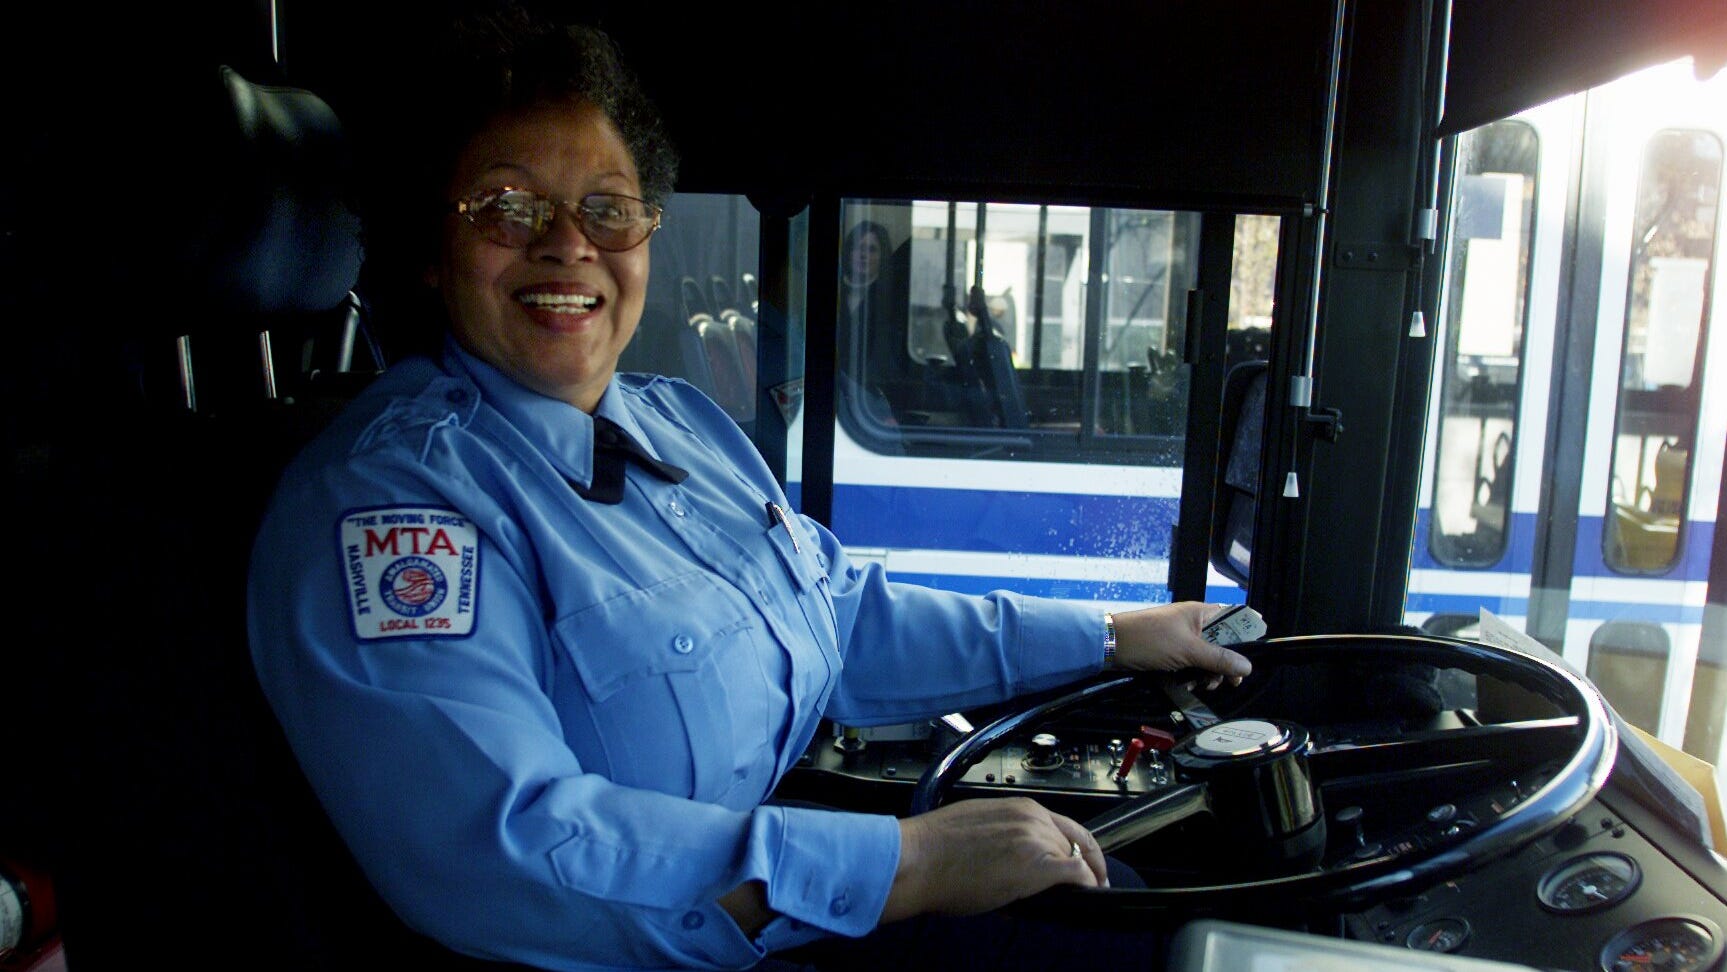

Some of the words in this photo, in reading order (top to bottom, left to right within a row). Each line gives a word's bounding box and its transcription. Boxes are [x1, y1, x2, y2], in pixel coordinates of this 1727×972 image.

[381, 514, 426, 524] MOVING
[364, 527, 459, 557] MTA
[347, 544, 370, 615] NASHVILLE
[457, 546, 474, 614] TENNESSEE
[379, 619, 419, 632] LOCAL
[424, 618, 452, 629] 1235
